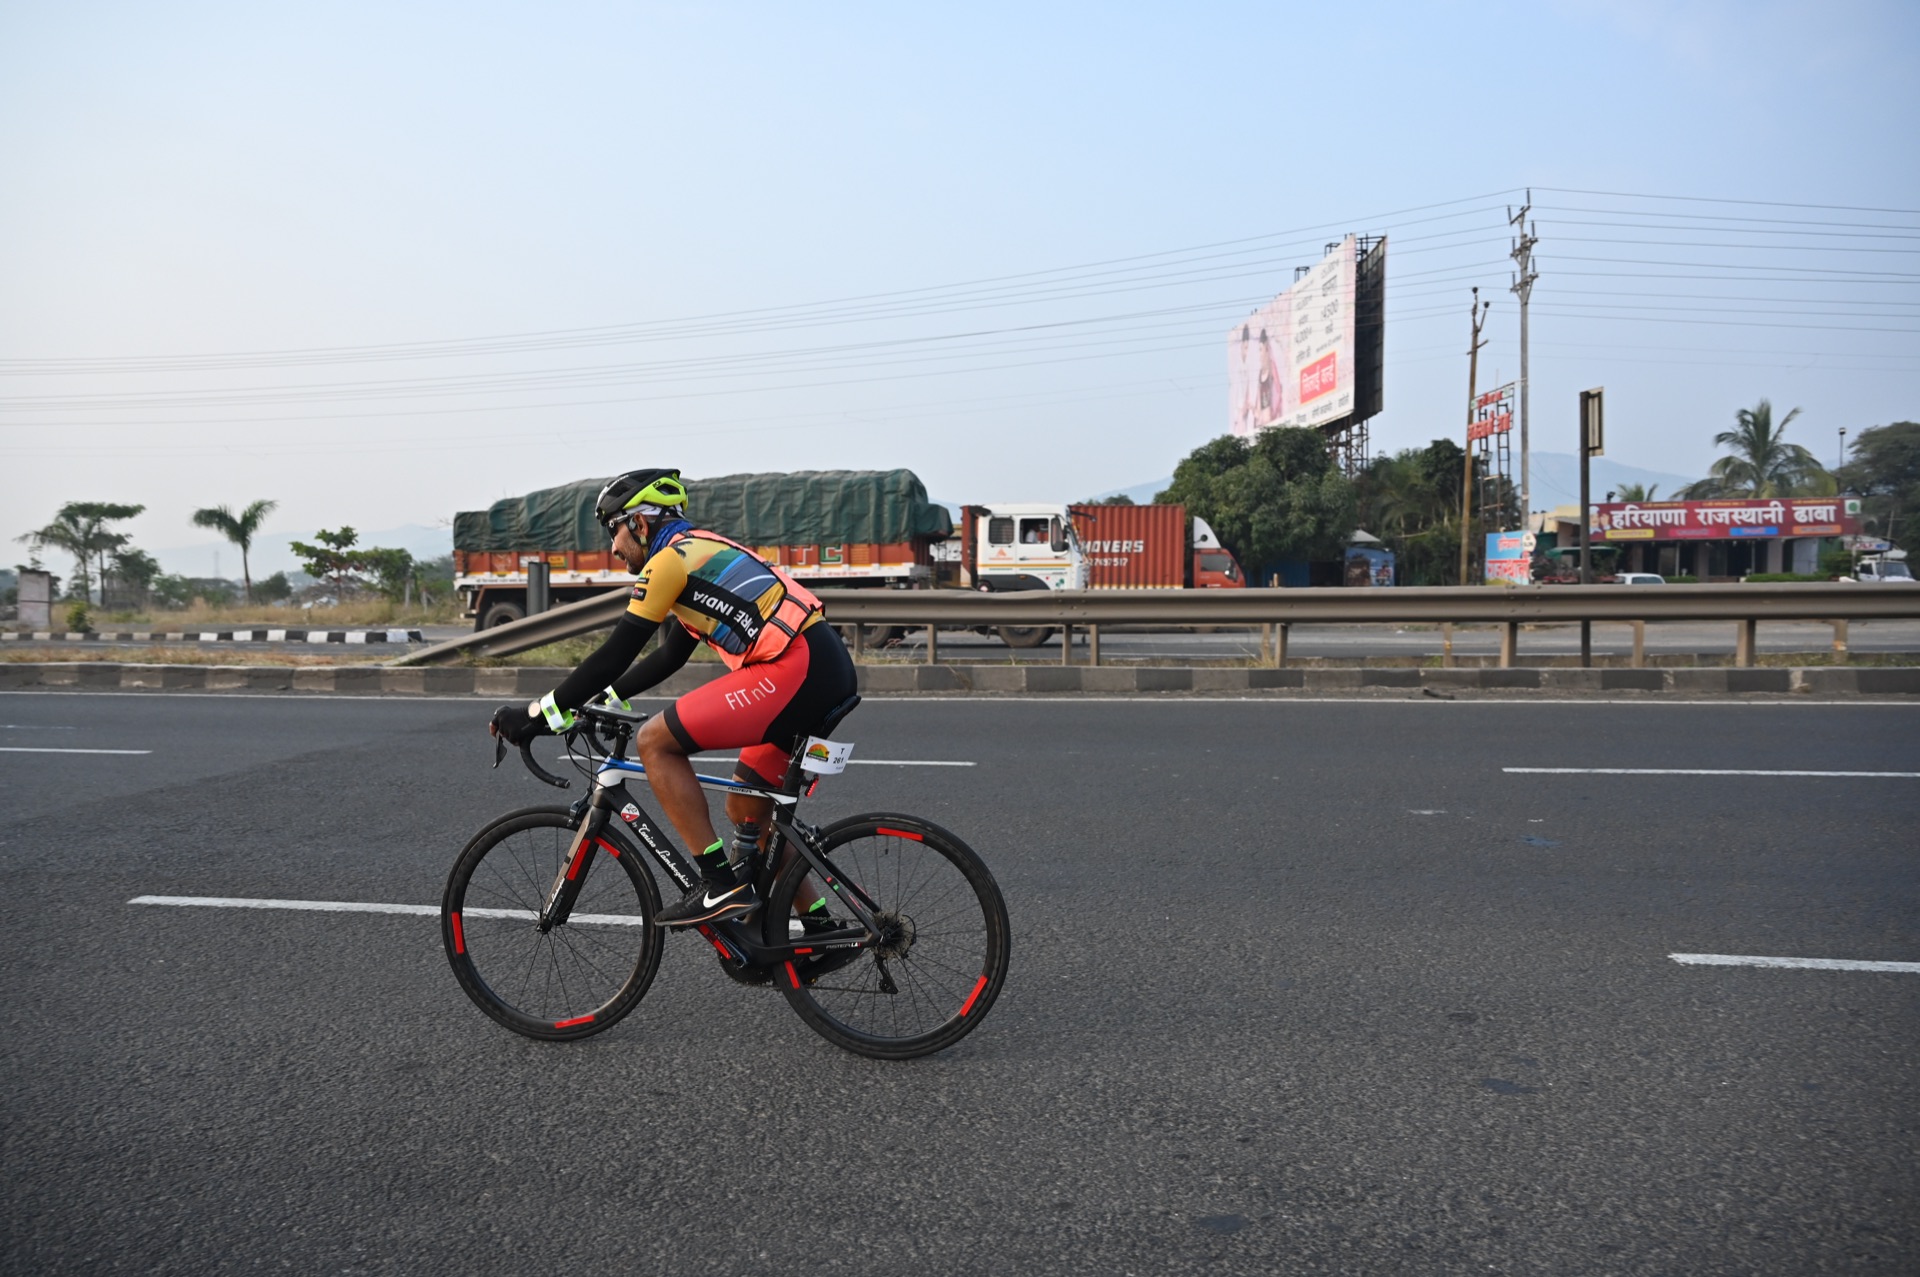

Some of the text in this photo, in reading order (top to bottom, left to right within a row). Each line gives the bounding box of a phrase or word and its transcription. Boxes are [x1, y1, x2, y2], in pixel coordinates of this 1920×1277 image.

[1610, 504, 1688, 529] हरियाणा
[1694, 499, 1785, 526] राजस्थानी
[1081, 540, 1145, 553] MOVERS
[692, 590, 759, 639] PIRE INDIA
[833, 756, 845, 764] 261
[840, 747, 846, 755] T
[638, 823, 693, 888] Tonino Lamborghini
